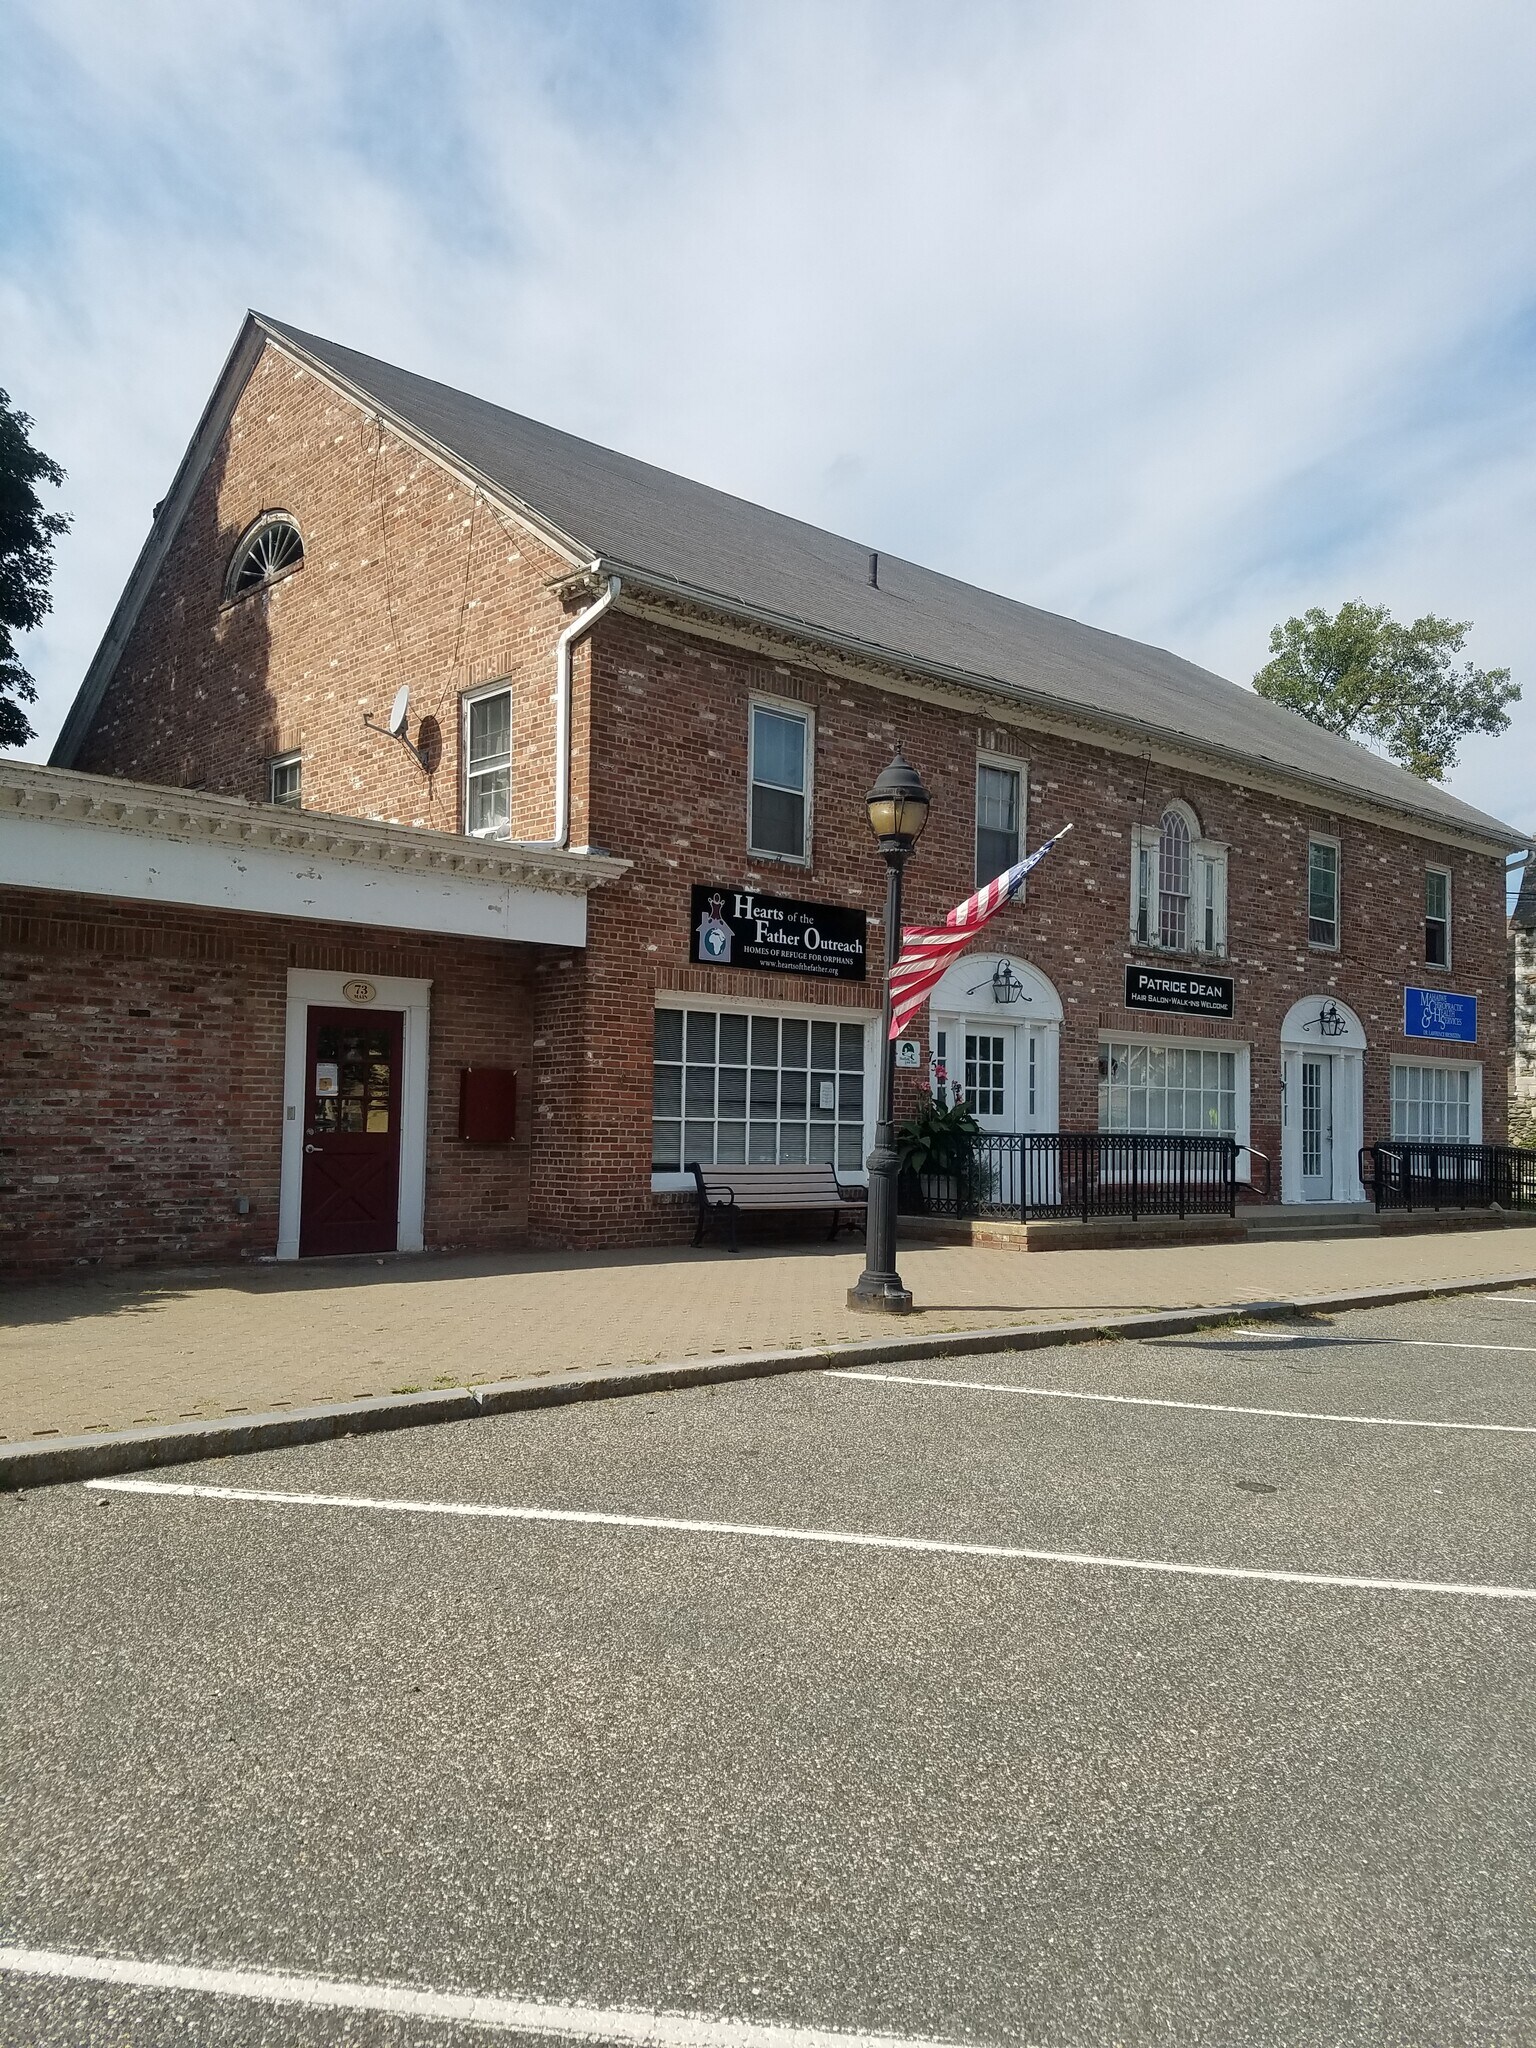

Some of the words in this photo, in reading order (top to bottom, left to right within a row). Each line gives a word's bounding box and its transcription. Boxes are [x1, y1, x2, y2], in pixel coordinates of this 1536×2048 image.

[733, 893, 784, 920] Hearts
[787, 912, 798, 923] of
[800, 914, 814, 925] the
[754, 919, 800, 946] Father
[804, 927, 863, 954] Outreach
[744, 945, 770, 955] HOMES
[770, 948, 780, 956] OF
[780, 950, 808, 960] REFUGE
[808, 953, 822, 962] FOR
[822, 954, 854, 965] ORPHANS
[760, 958, 839, 976] www.heartsofthefather.org
[354, 985, 368, 994] 73
[1139, 975, 1187, 994] PATRICE
[1190, 981, 1222, 998] DEAN
[1131, 992, 1147, 1002] HAIR
[1200, 1001, 1229, 1010] WELCOME
[1421, 1007, 1432, 1028] &
